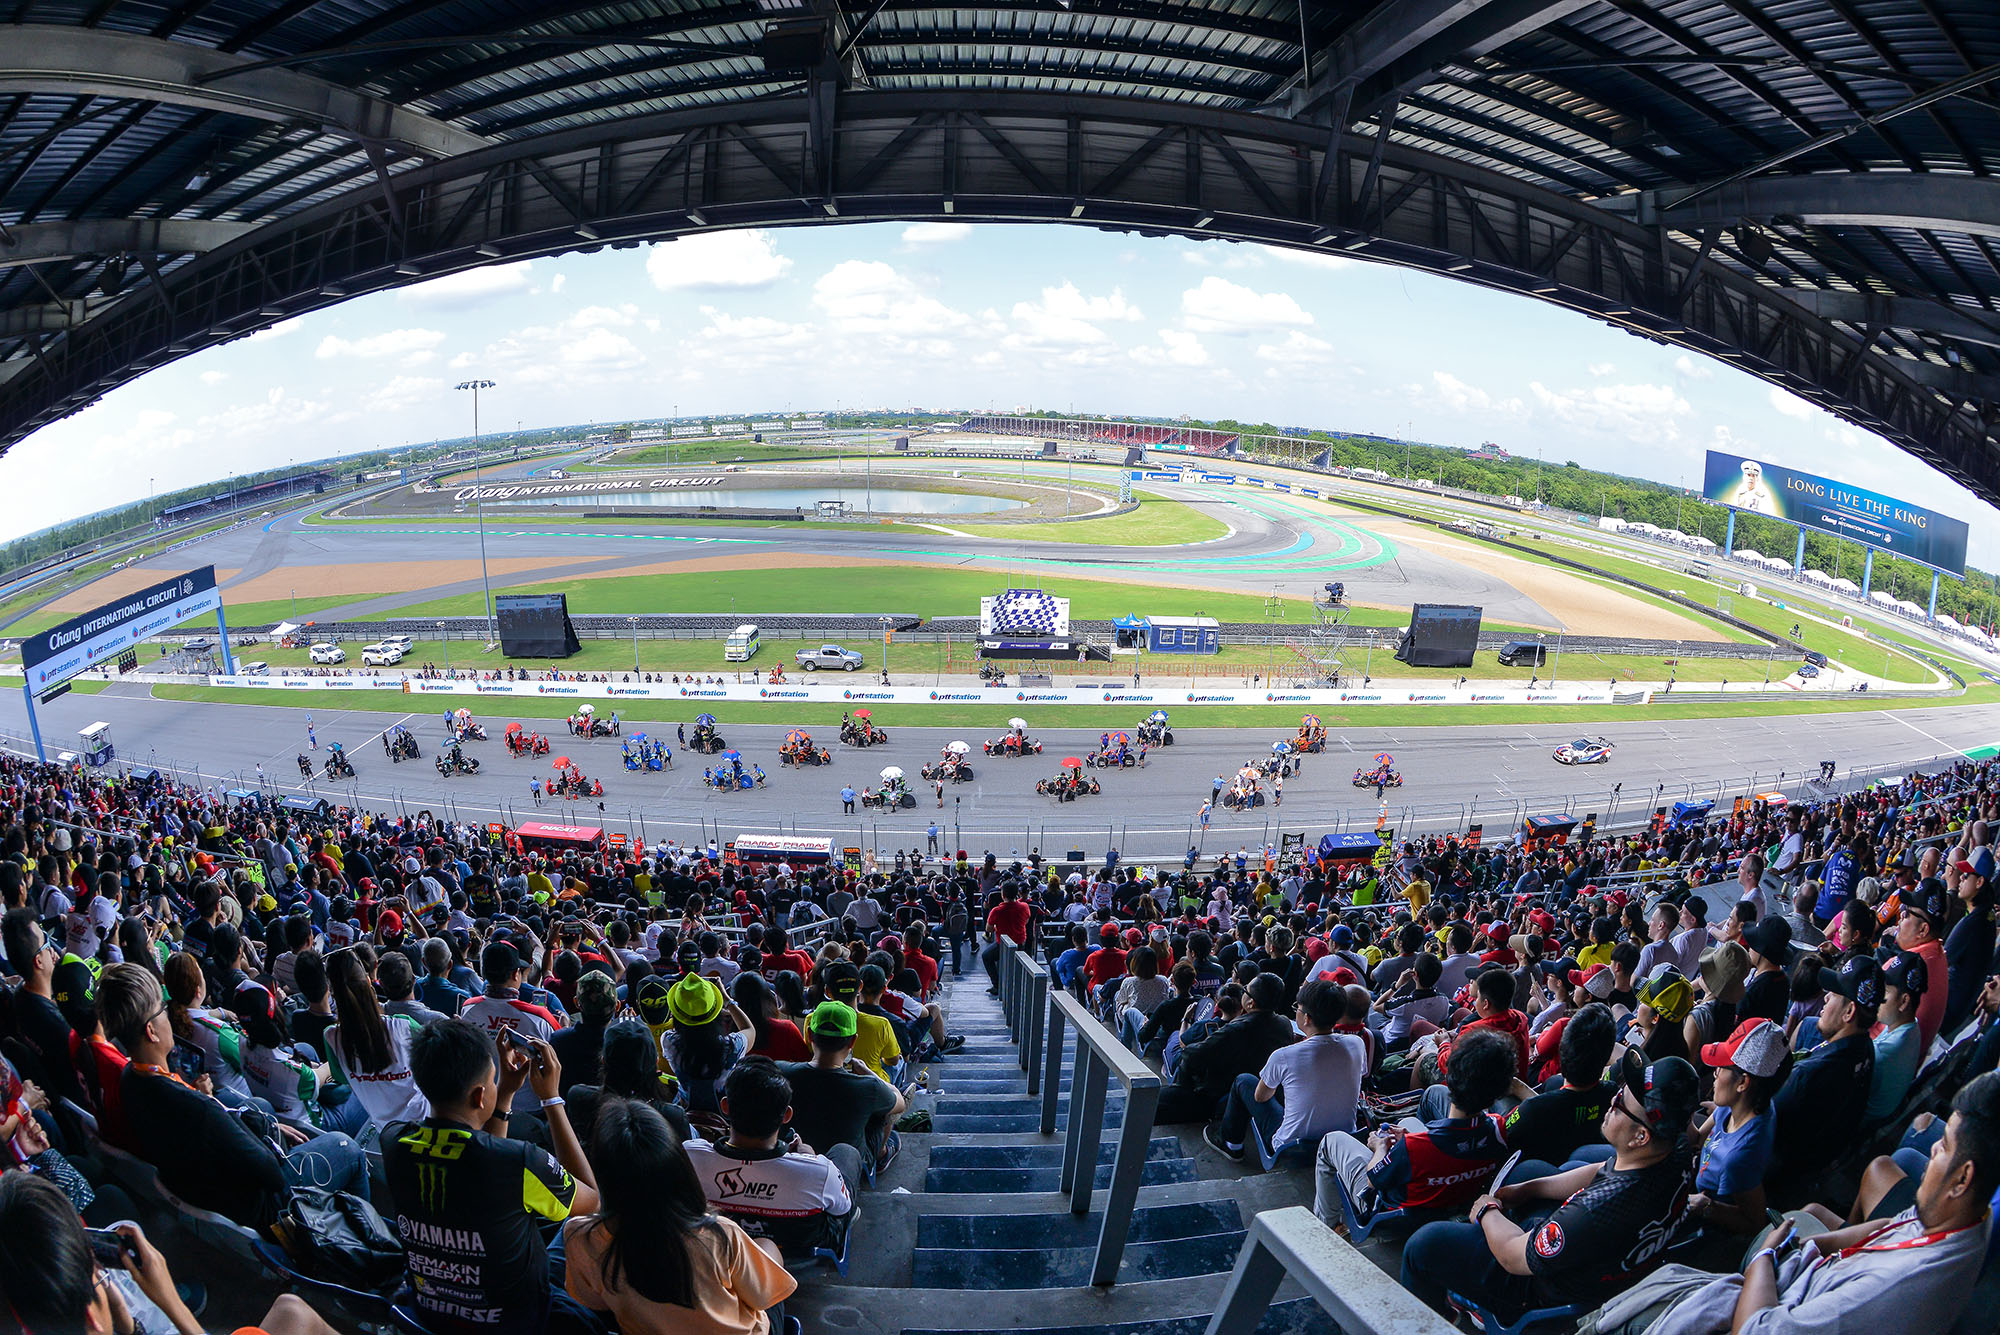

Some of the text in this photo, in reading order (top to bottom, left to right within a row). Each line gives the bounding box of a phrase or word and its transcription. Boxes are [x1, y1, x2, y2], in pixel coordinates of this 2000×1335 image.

[454, 476, 726, 500] Chang INTERNATIONAL CIRCUIT
[1786, 477, 1825, 496] LONG
[1830, 488, 1860, 507] LIVE
[1864, 498, 1890, 517] THE
[1894, 508, 1927, 528] KING
[50, 588, 177, 650] Chang INTERNATIONAL CIRCUIT
[540, 825, 580, 833] DUCATI
[736, 840, 781, 848] PRAMAC
[784, 842, 830, 850] PRAMAC
[56, 992, 68, 1002] 46
[640, 995, 668, 1008] 46
[488, 1015, 520, 1030] YSS
[398, 1127, 472, 1160] 46
[1427, 1162, 1496, 1186] HONDA
[745, 1182, 778, 1197] NPC
[410, 1219, 486, 1252] YAMAHA
[422, 1265, 480, 1286] DEPAN
[436, 1286, 482, 1300] MICHELIN
